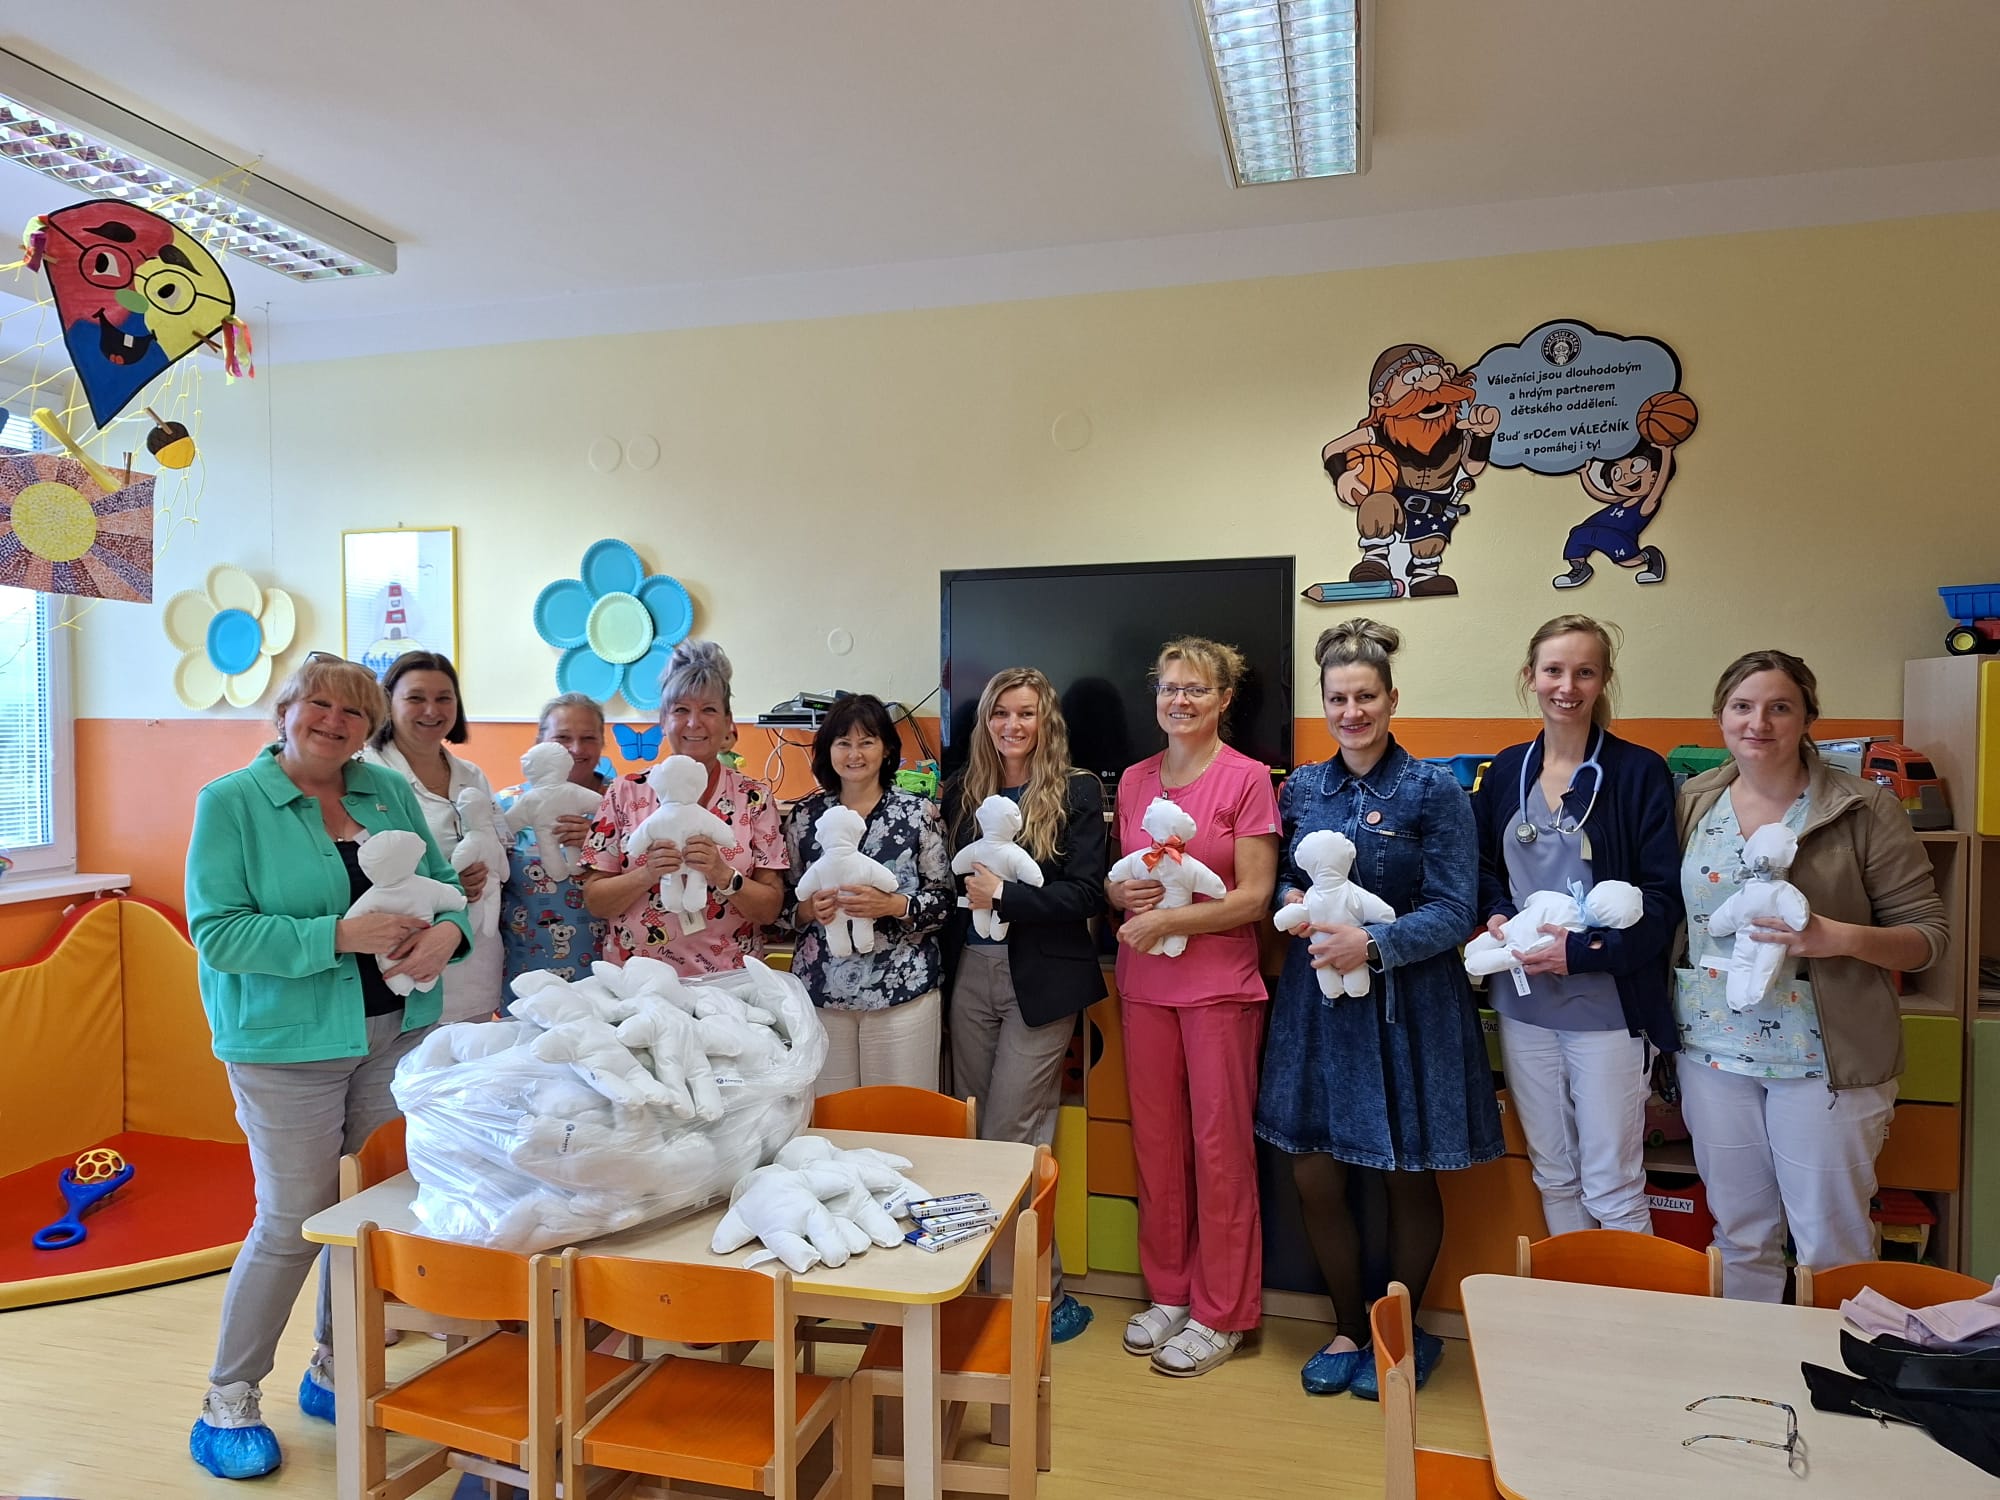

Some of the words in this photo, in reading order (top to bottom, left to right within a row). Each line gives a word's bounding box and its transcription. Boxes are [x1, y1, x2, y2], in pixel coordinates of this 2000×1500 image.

[1487, 371, 1536, 386] Válečníci
[1536, 370, 1562, 384] jsou
[1565, 361, 1642, 379] dlouhodobým
[1508, 391, 1516, 400] a
[1518, 385, 1553, 401] hrdým
[1556, 382, 1615, 399] partnerem
[1510, 402, 1563, 417] dětského
[1566, 396, 1618, 411] oddělení.
[1497, 431, 1521, 443] Buď
[1523, 427, 1567, 440] srDCem
[1570, 420, 1629, 436] VÁLEČNÍK
[1524, 446, 1531, 456] a
[1533, 442, 1577, 457] pomáhej
[1586, 438, 1602, 451] ty!
[1610, 507, 1625, 518] 14
[1614, 548, 1626, 558] 14
